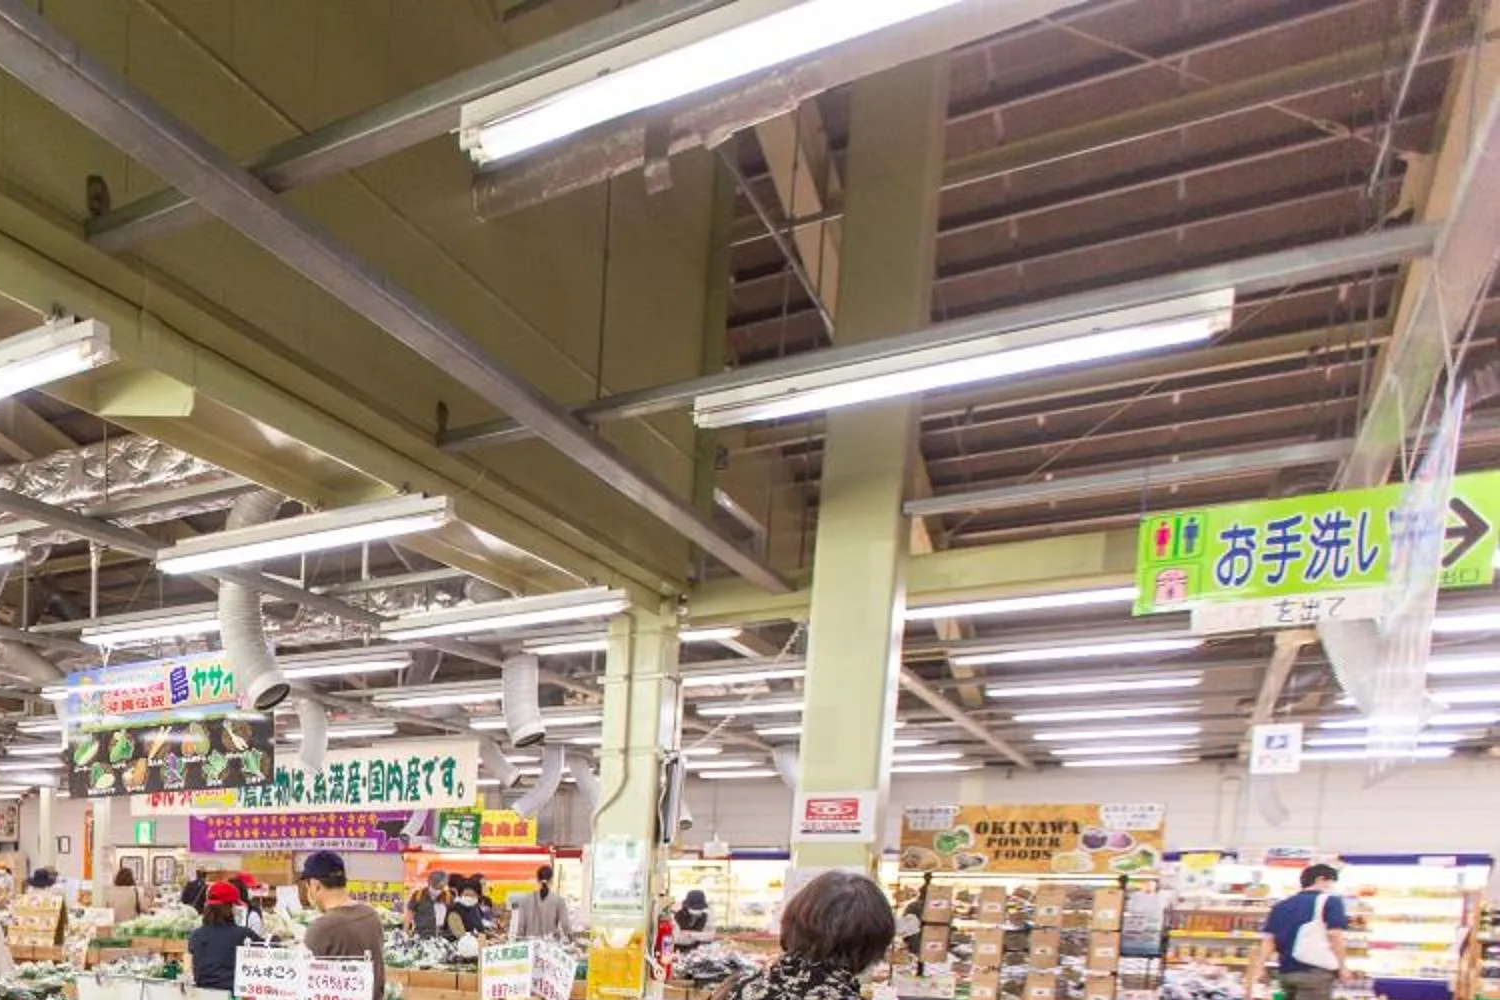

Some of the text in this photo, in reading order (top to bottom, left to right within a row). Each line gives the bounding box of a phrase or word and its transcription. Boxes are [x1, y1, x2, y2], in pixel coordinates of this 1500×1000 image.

[974, 820, 1081, 836] OKINAWA
[985, 835, 1061, 849] POWDER
[992, 849, 1054, 862] FOODS
